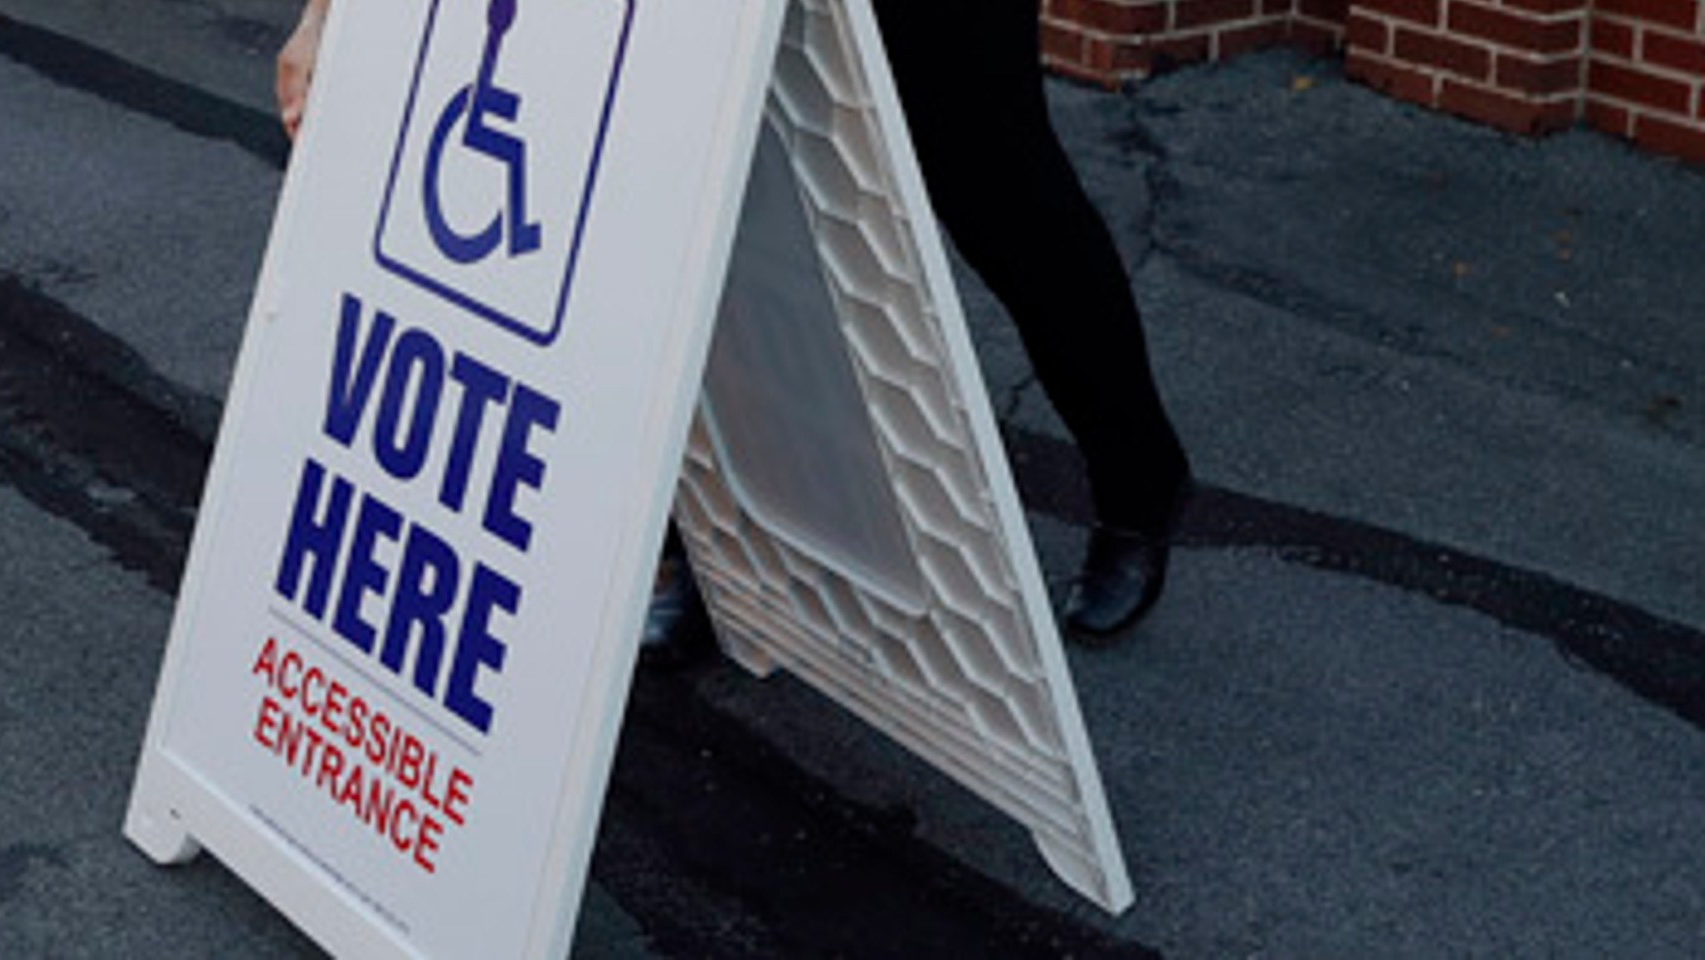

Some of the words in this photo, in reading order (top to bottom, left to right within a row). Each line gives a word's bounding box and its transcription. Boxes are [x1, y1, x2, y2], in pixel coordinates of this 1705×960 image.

[323, 292, 561, 553] VOTE
[274, 456, 522, 735] HERE
[252, 637, 473, 826] ACCESSIBLE
[253, 696, 443, 874] ENTRANCE
